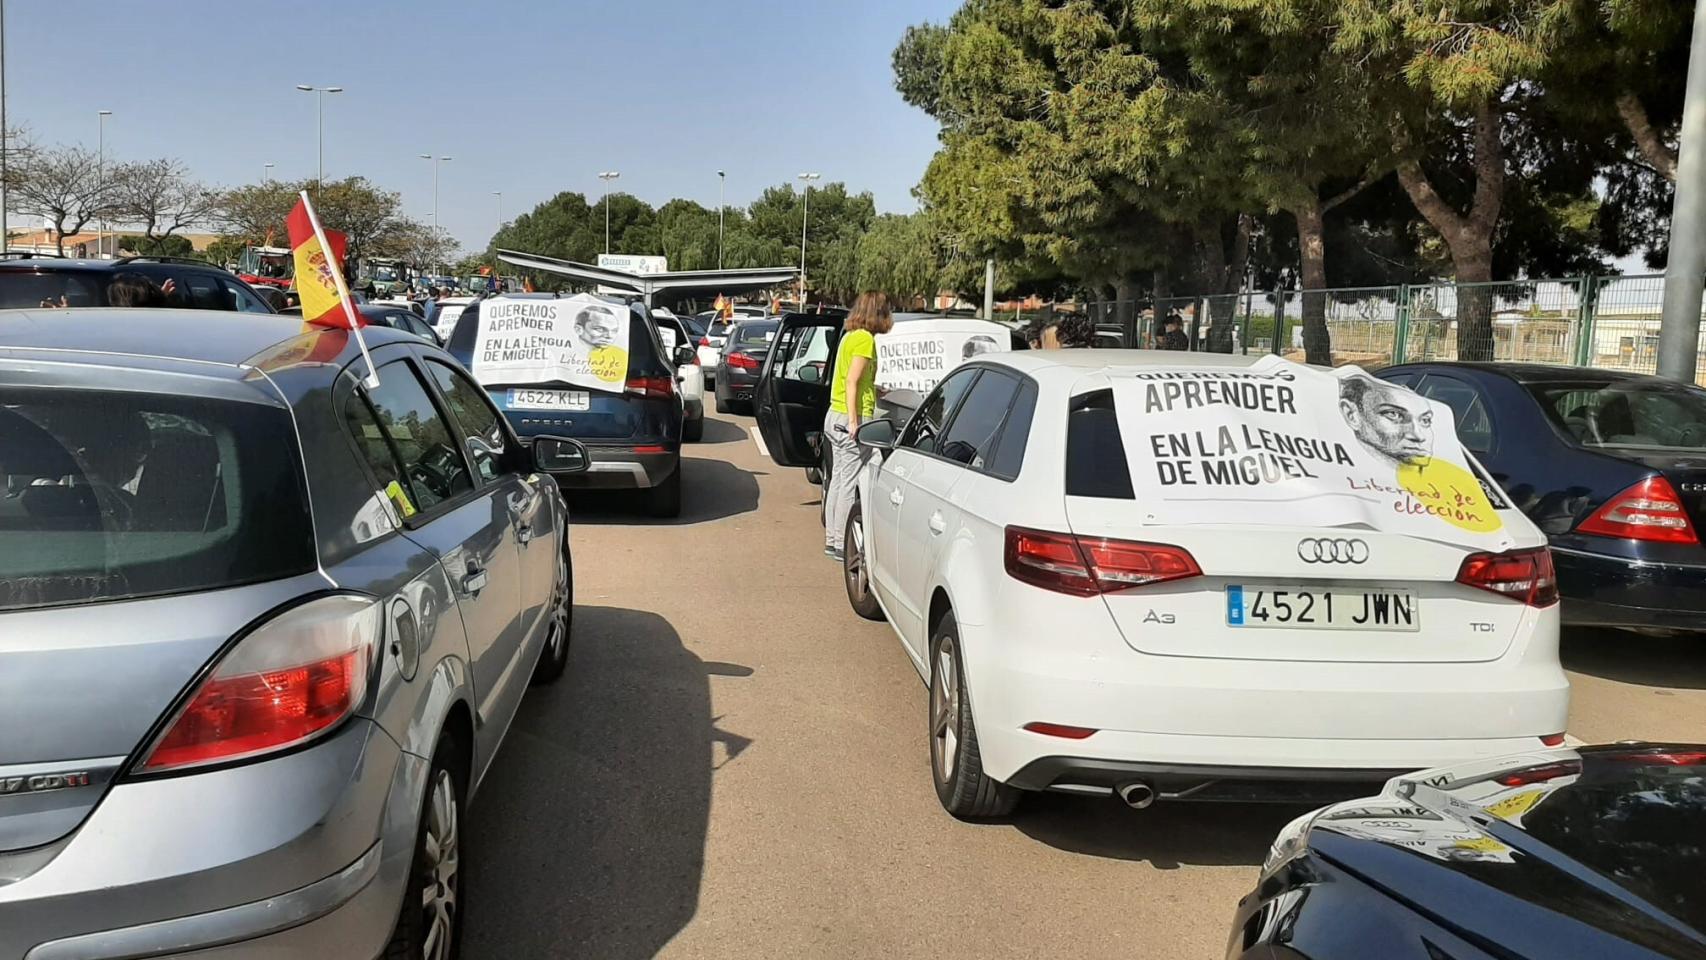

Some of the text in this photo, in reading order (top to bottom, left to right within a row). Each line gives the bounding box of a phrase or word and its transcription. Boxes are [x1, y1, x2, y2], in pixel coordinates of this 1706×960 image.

[490, 304, 557, 319] QUEREMOS
[489, 317, 553, 332] APRENDER
[485, 336, 572, 350] EN LA LENGUA
[880, 340, 944, 358] QUEREMOS
[483, 347, 548, 362] DE MIGUEL
[560, 353, 605, 365] Libertad
[881, 356, 943, 373] APRENDER
[1136, 369, 1296, 382] QUEREMOS
[518, 390, 585, 405] 4522 KLL
[1145, 380, 1297, 414] APRENDER
[1150, 424, 1355, 467] EN LA LENGUA
[1156, 453, 1319, 486] DE MIGUEL
[1346, 476, 1440, 499] Libertad
[1450, 485, 1475, 505] de
[1251, 591, 1412, 625] 4521 JWN
[1142, 608, 1176, 624] A3
[1469, 622, 1495, 632] TDI
